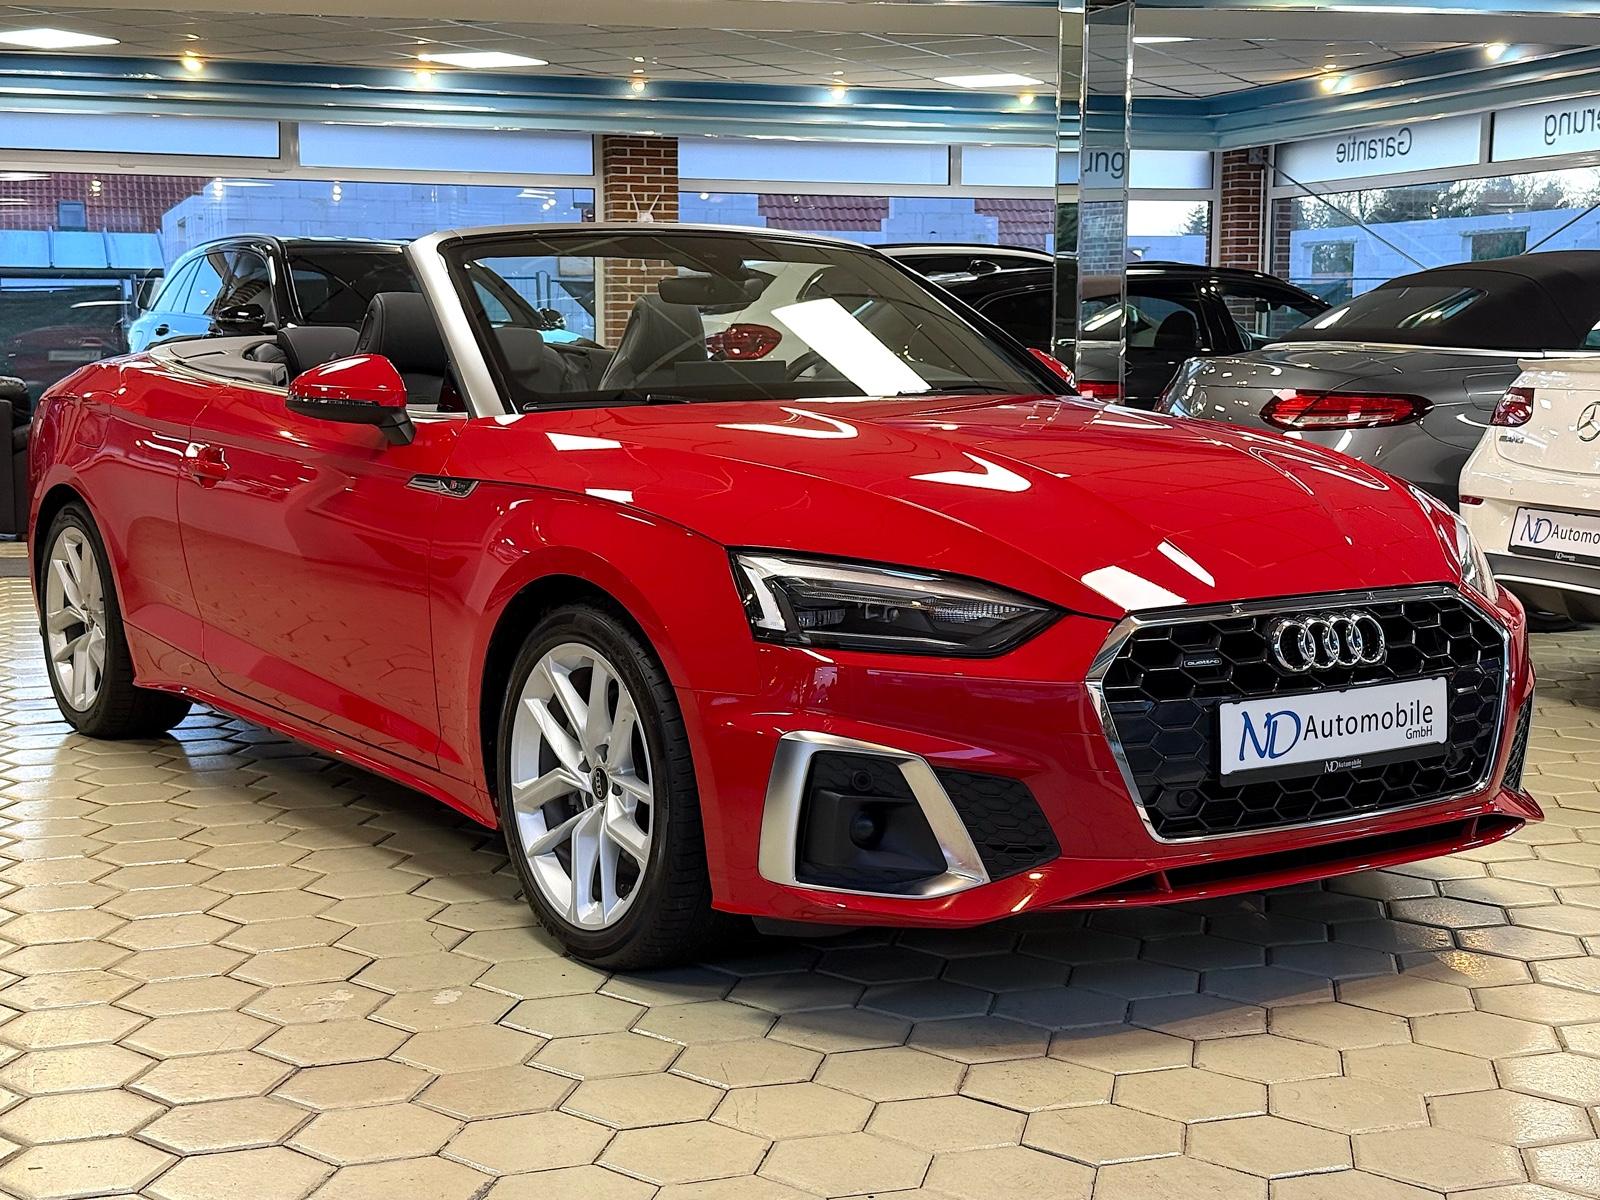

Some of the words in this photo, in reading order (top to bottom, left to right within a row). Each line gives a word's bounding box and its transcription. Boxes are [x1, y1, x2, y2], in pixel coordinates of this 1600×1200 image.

[1520, 514, 1553, 544] ND
[1238, 710, 1302, 761] ND
[1303, 699, 1433, 740] Automobile
[1405, 724, 1433, 740] GmbH
